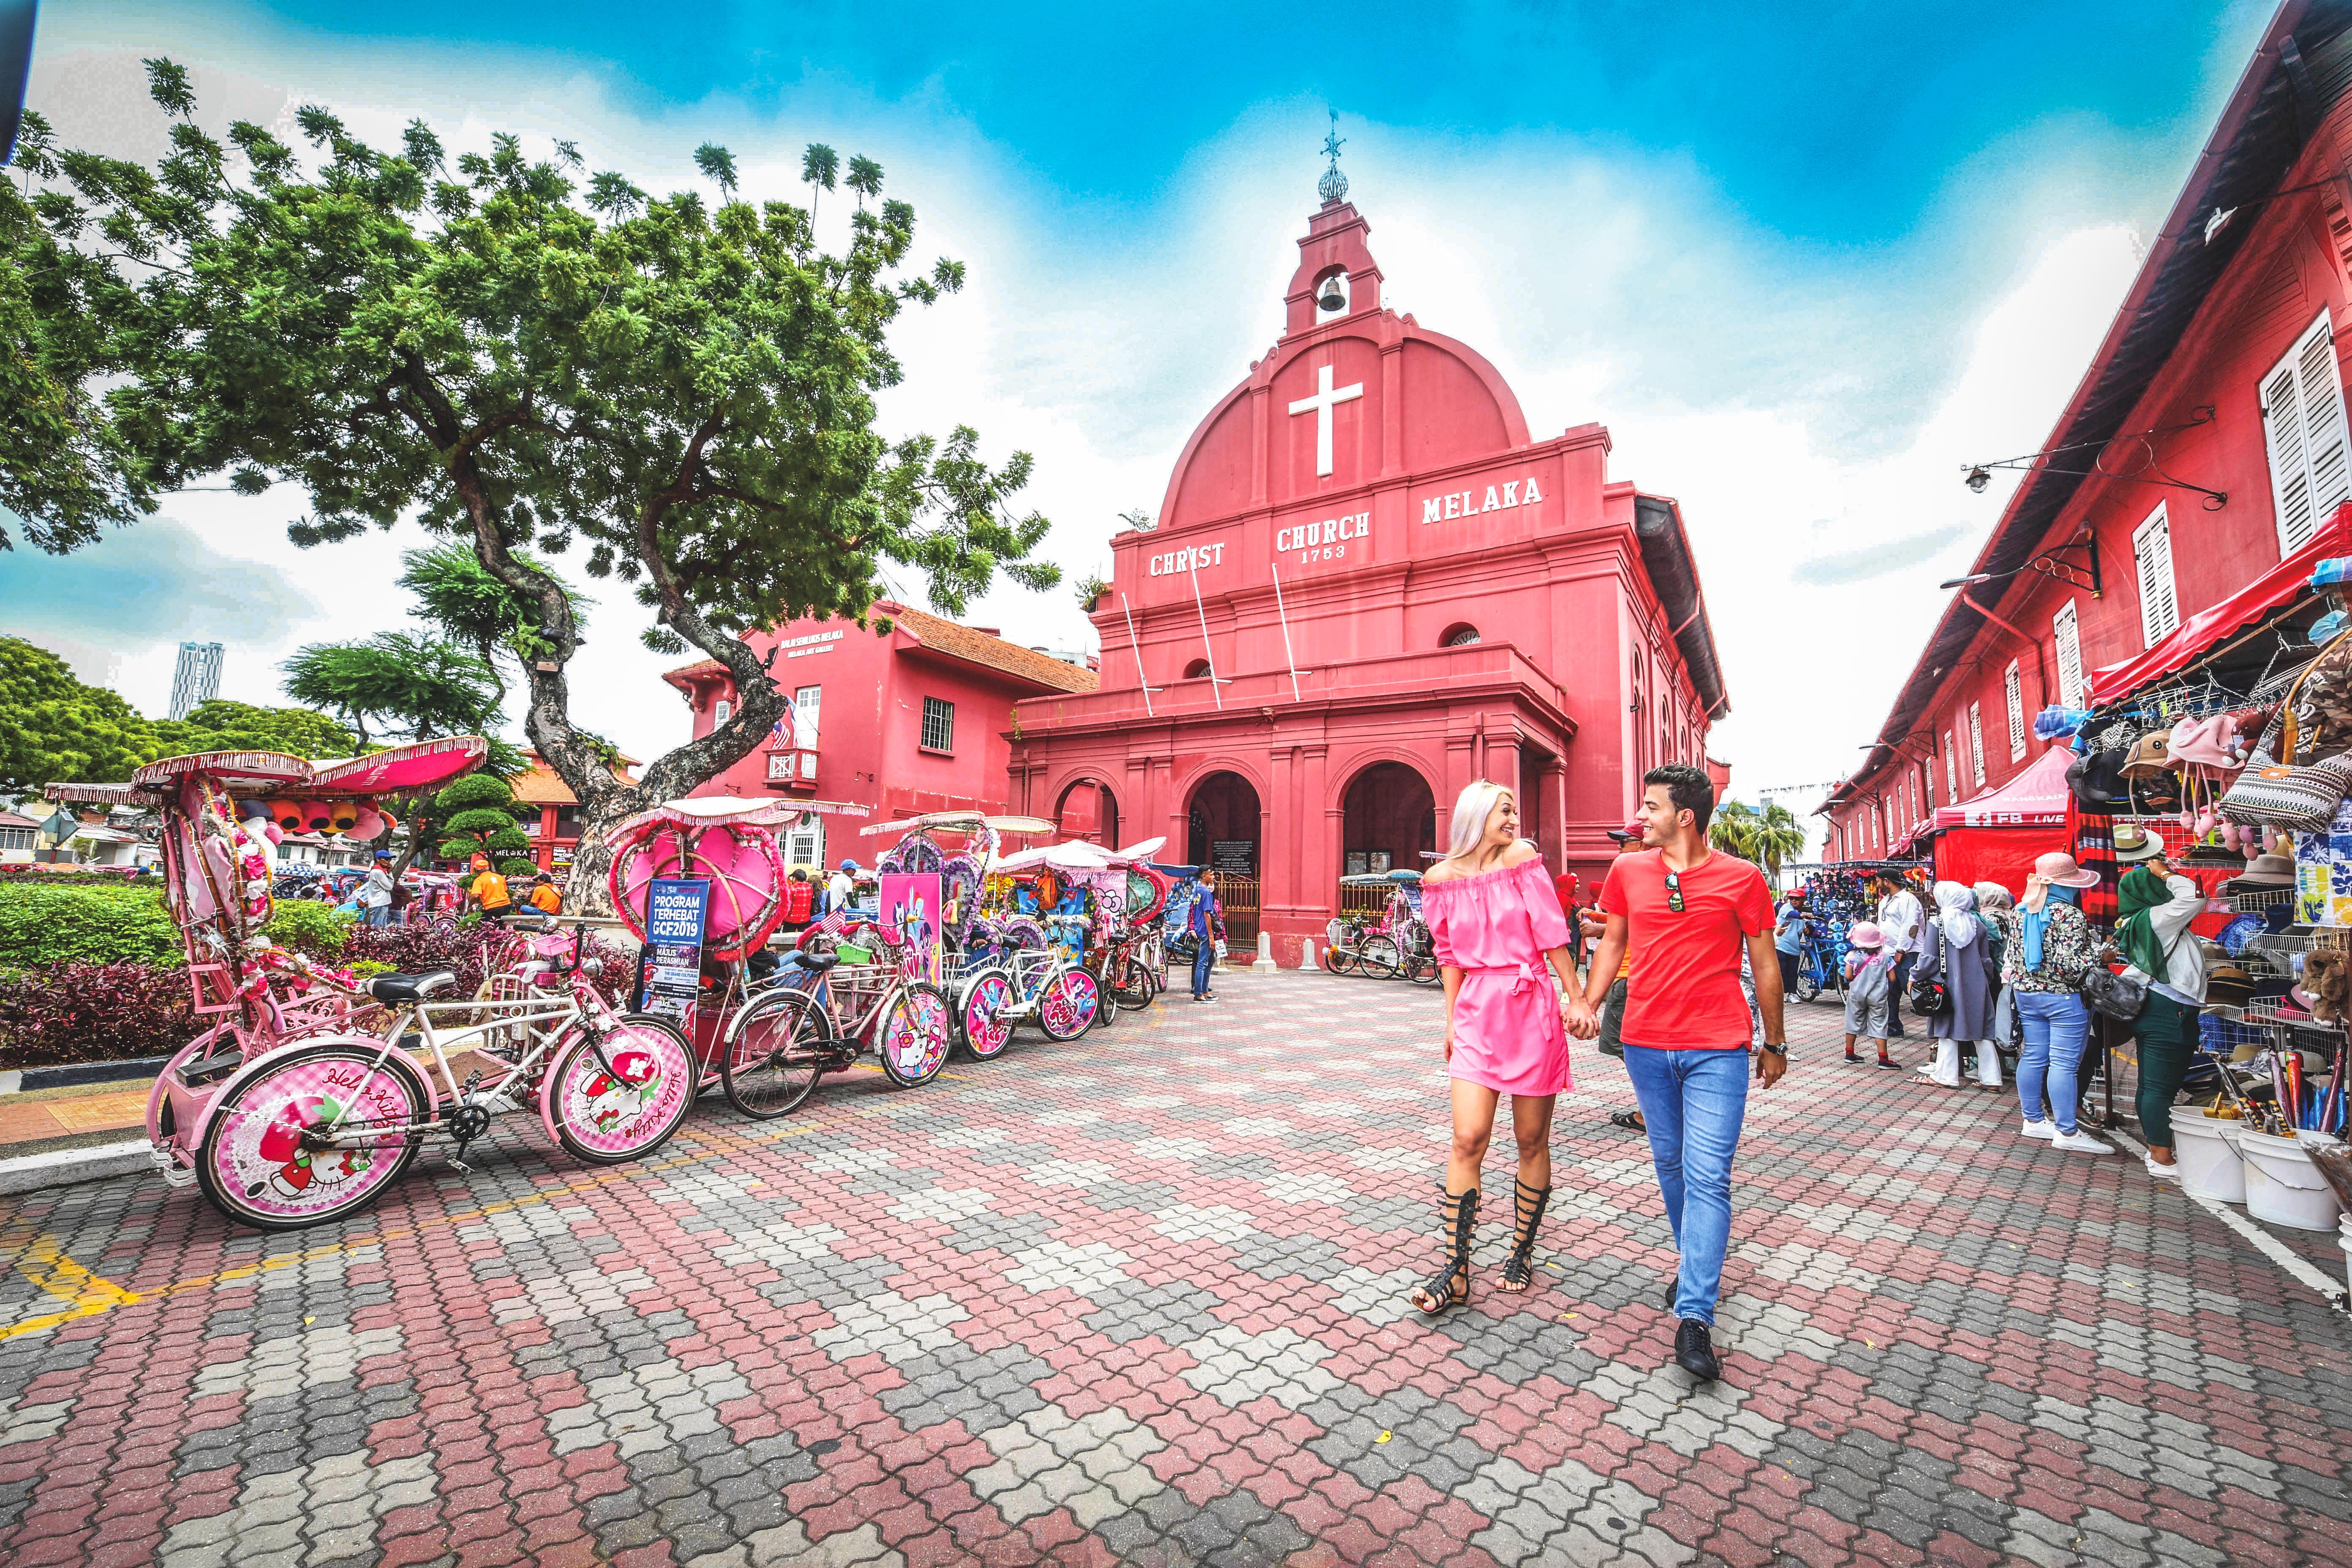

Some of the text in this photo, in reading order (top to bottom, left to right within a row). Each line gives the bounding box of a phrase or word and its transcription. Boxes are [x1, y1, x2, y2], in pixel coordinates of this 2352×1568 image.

[1150, 477, 1542, 577] CHRIST CHURCH MELAKA
[1301, 545, 1345, 564] 1753
[821, 629, 844, 642] MELAKA
[815, 644, 834, 654] GALLERY
[1997, 813, 2023, 824] FB
[2034, 814, 2065, 823] LIVE
[654, 896, 700, 908] PROGRAM
[654, 908, 700, 921] TERHEBAT
[653, 921, 698, 937] GCF2019
[656, 948, 677, 956] MAJLIS
[656, 956, 689, 966] PERASMIAN
[652, 1007, 675, 1015] CHALLENGE
[634, 1070, 681, 1138] Hello Kitty
